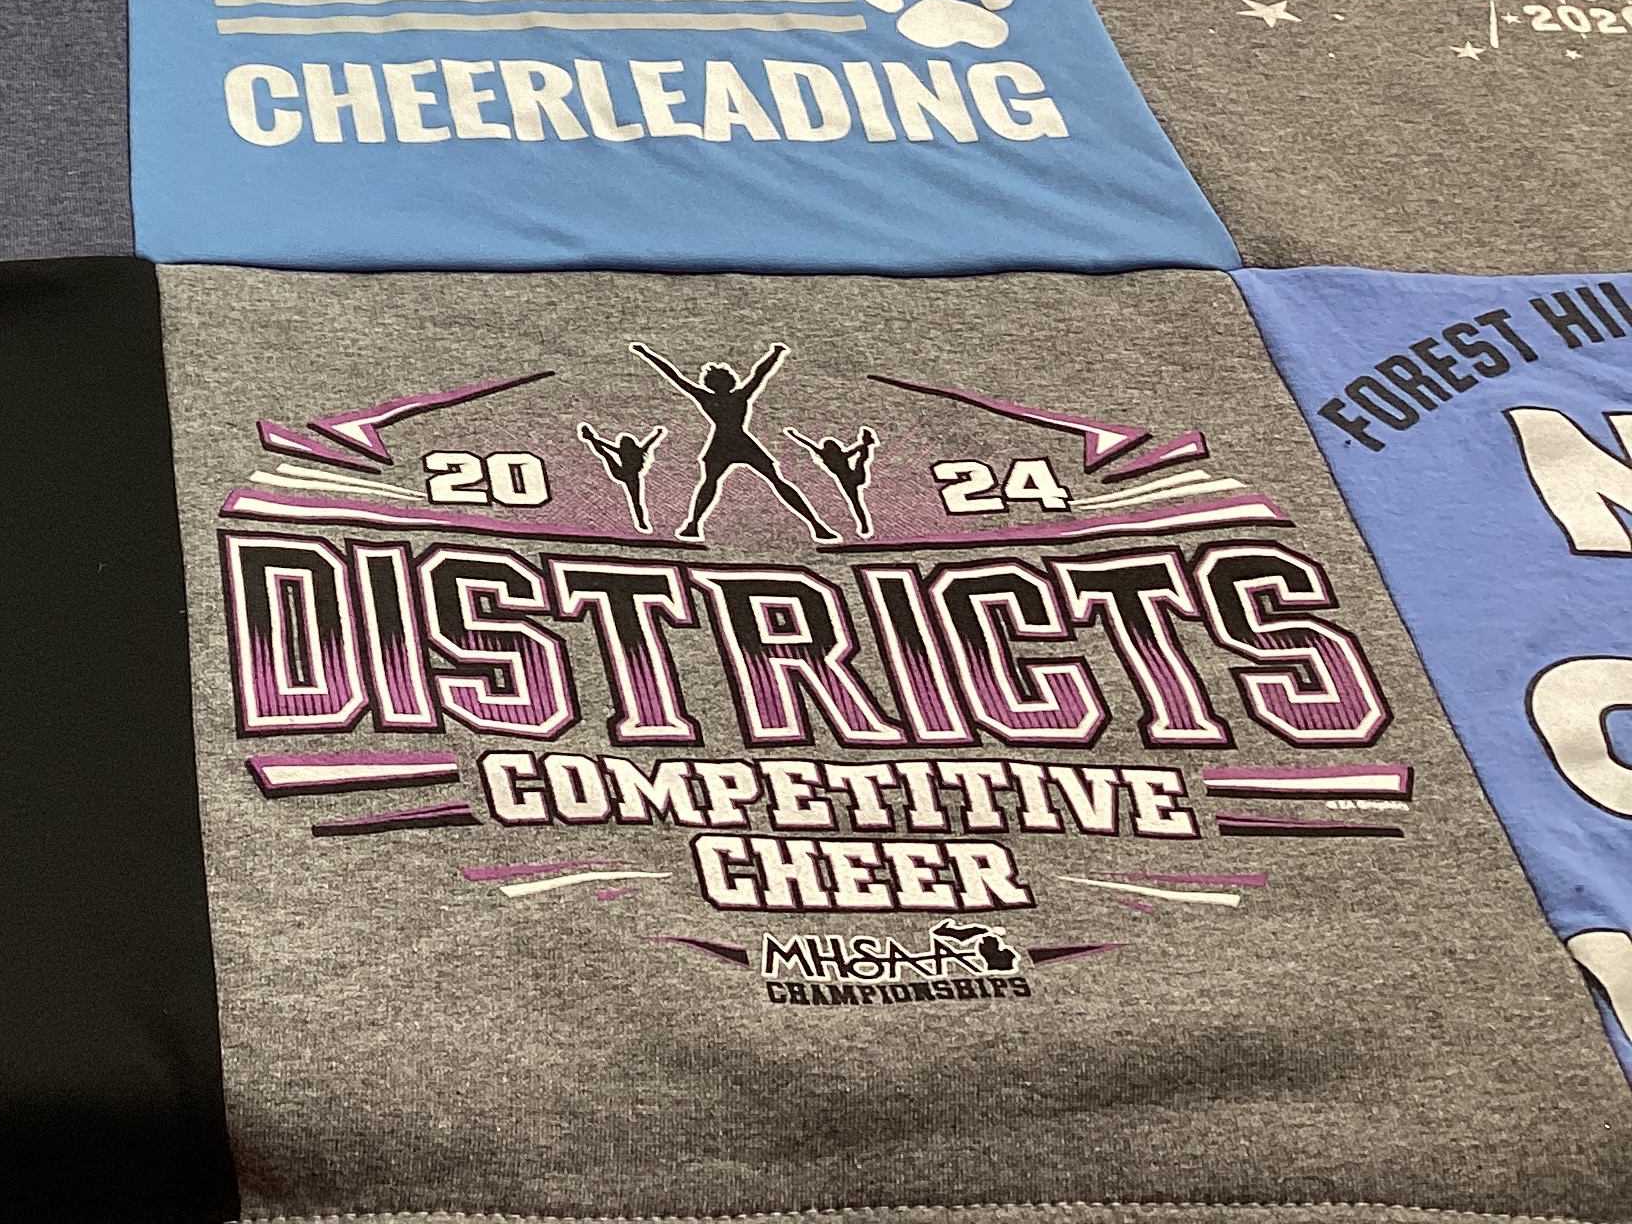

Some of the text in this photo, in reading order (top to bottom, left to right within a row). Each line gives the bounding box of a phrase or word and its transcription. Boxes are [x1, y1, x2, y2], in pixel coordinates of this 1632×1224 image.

[224, 58, 1070, 147] CHEERLEADING
[1317, 307, 1540, 454] FOREST
[424, 449, 1073, 517] 20 24
[218, 527, 1393, 751] DISTRICTS
[478, 750, 1204, 839] COMPETITIVE
[693, 832, 1036, 912] CHEER
[762, 930, 984, 978] MHSAA
[766, 972, 1034, 1006] CHAMPIONSHIPS
